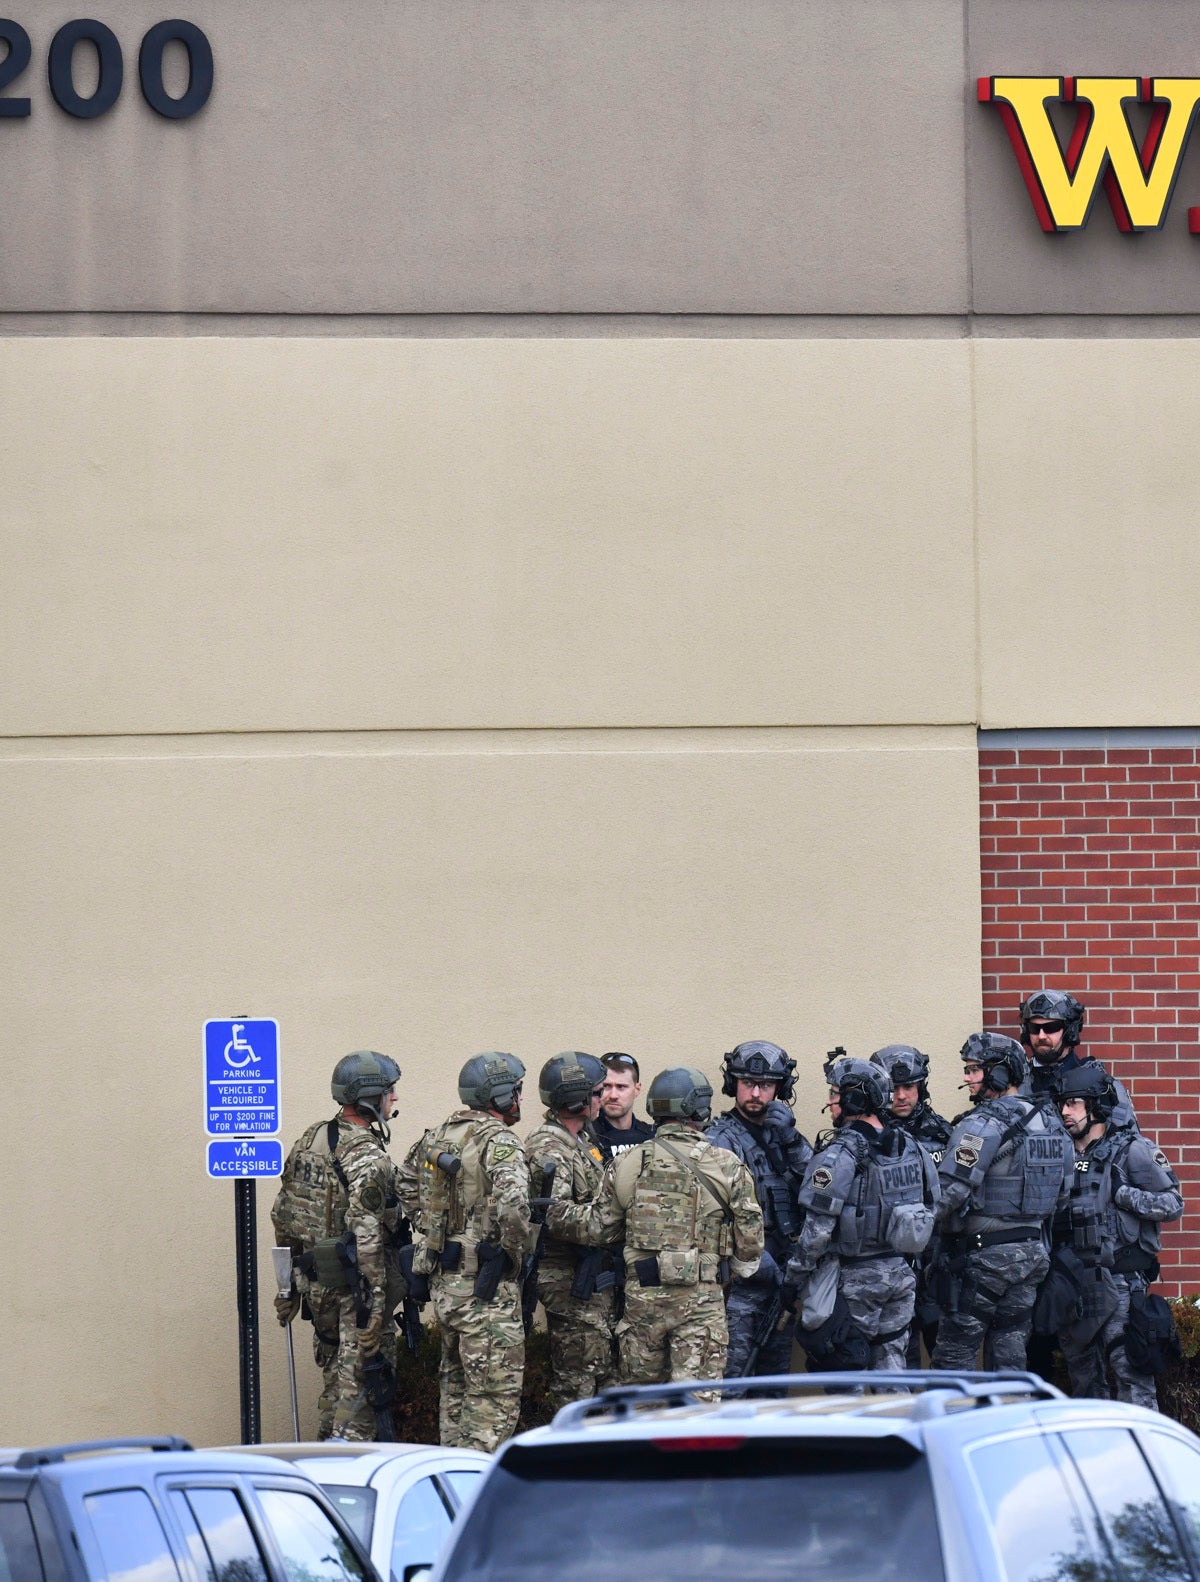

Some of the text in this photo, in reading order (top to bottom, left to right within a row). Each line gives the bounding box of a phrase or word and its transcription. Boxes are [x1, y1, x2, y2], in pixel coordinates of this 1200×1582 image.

[223, 1070, 261, 1078] PARKING
[218, 1086, 253, 1095] VEHICLE
[222, 1096, 264, 1104] REQUIRED
[210, 1113, 220, 1121] UP
[236, 1112, 256, 1121] $200
[260, 1112, 275, 1120] FINE
[234, 1122, 271, 1130] VILATION
[235, 1147, 256, 1156] VAN
[1028, 1138, 1064, 1159] POLICE
[212, 1161, 278, 1171] ACCESSIBLE
[883, 1163, 920, 1190] POLICE
